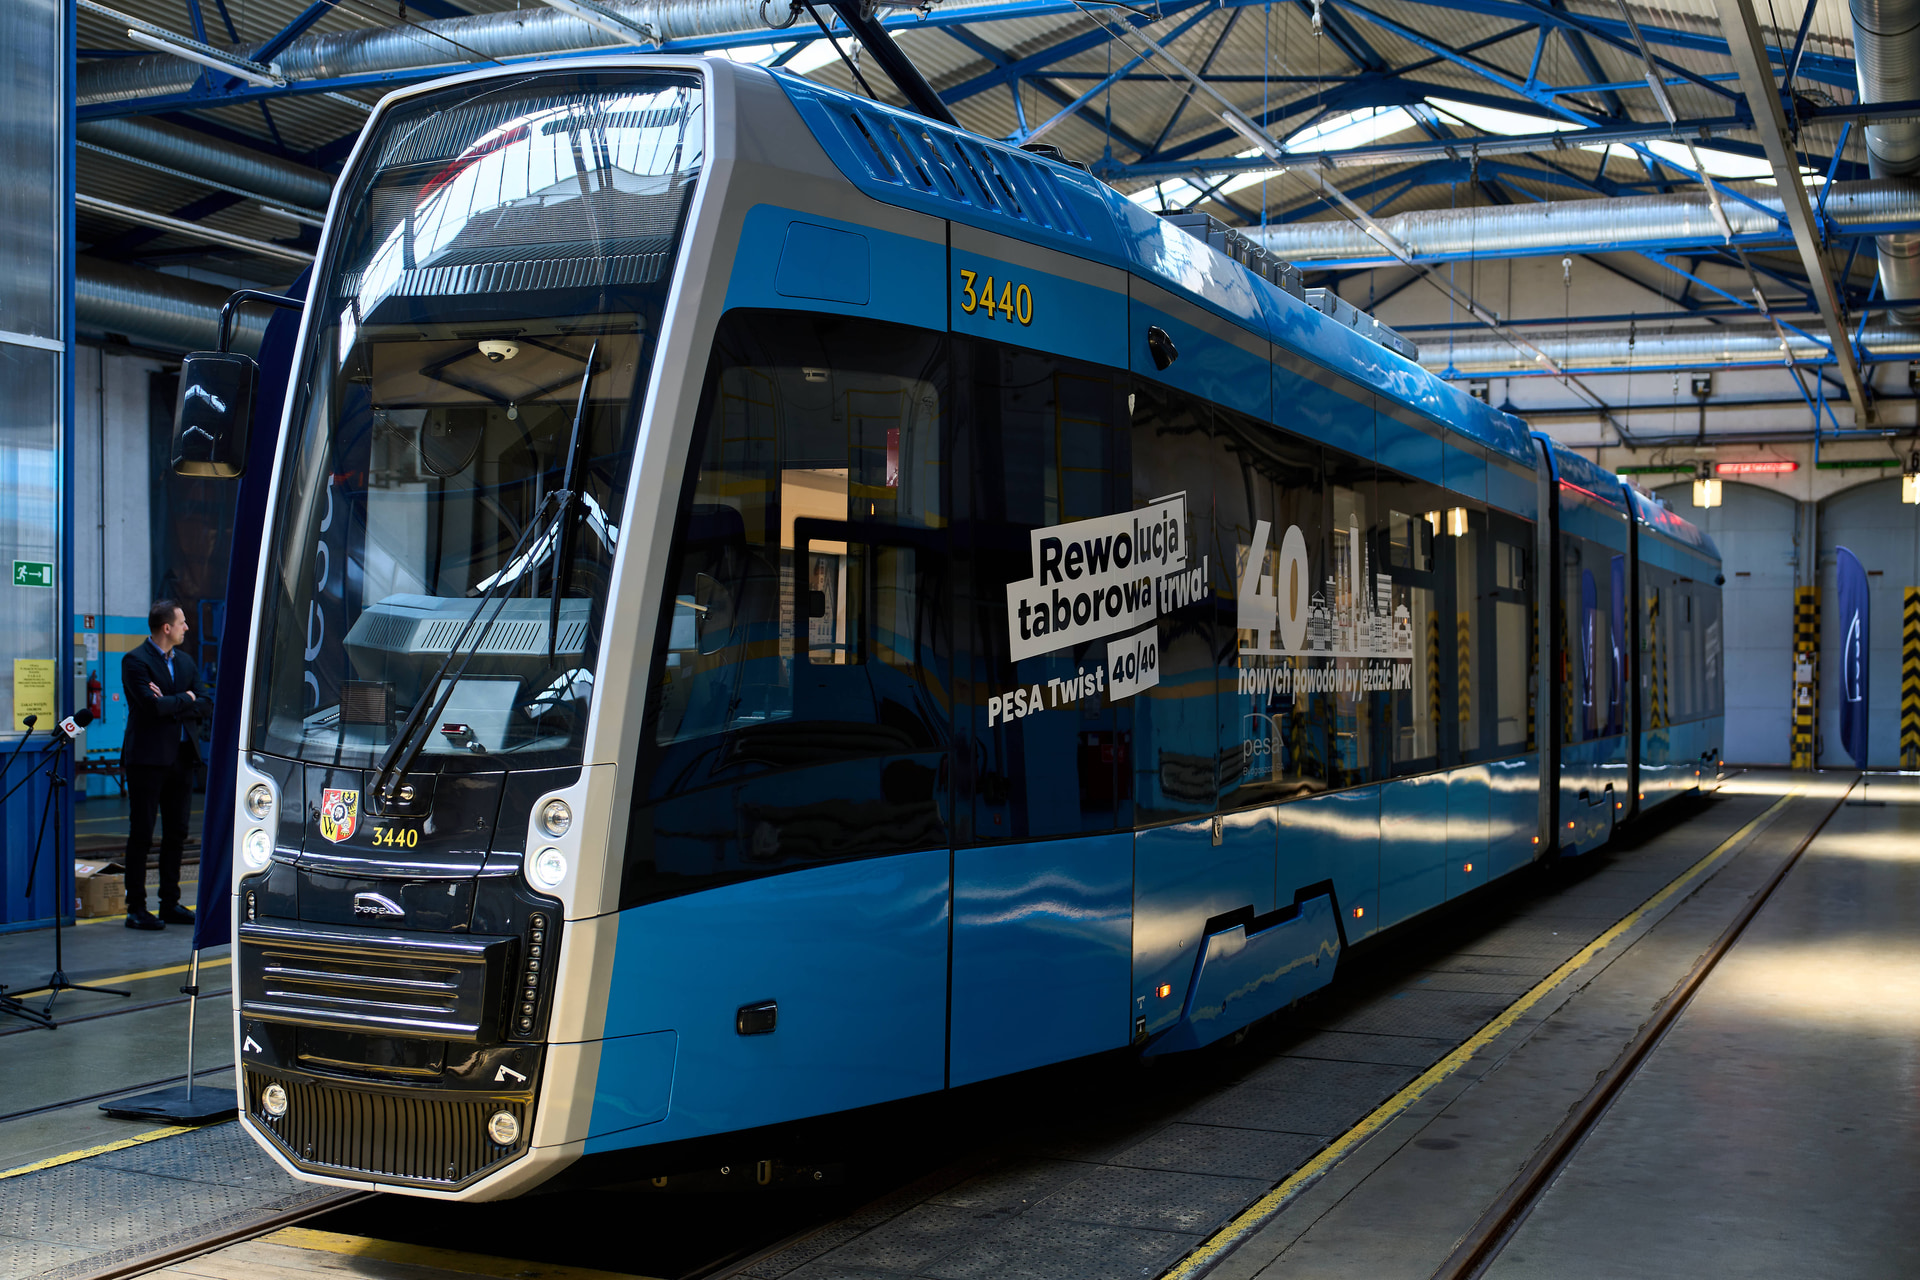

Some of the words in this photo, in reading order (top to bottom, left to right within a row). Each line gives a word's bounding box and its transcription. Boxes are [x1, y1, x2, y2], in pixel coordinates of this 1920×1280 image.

[960, 268, 1034, 327] 3440
[1911, 452, 1920, 470] 6
[1040, 510, 1179, 586] Rewolucja
[1018, 576, 1151, 641] taborowa
[1159, 555, 1209, 615] trwa!
[1237, 520, 1309, 651] 40
[988, 684, 1044, 728] PESA
[1047, 665, 1104, 708] Twist
[1112, 641, 1156, 684] 40/40
[1238, 661, 1291, 706] nowych
[1292, 659, 1344, 705] powodów
[1345, 662, 1359, 702] by
[1358, 659, 1391, 702] jeździć
[1392, 663, 1411, 690] MPK
[1243, 737, 1280, 763] pesa
[372, 826, 418, 848] 3440
